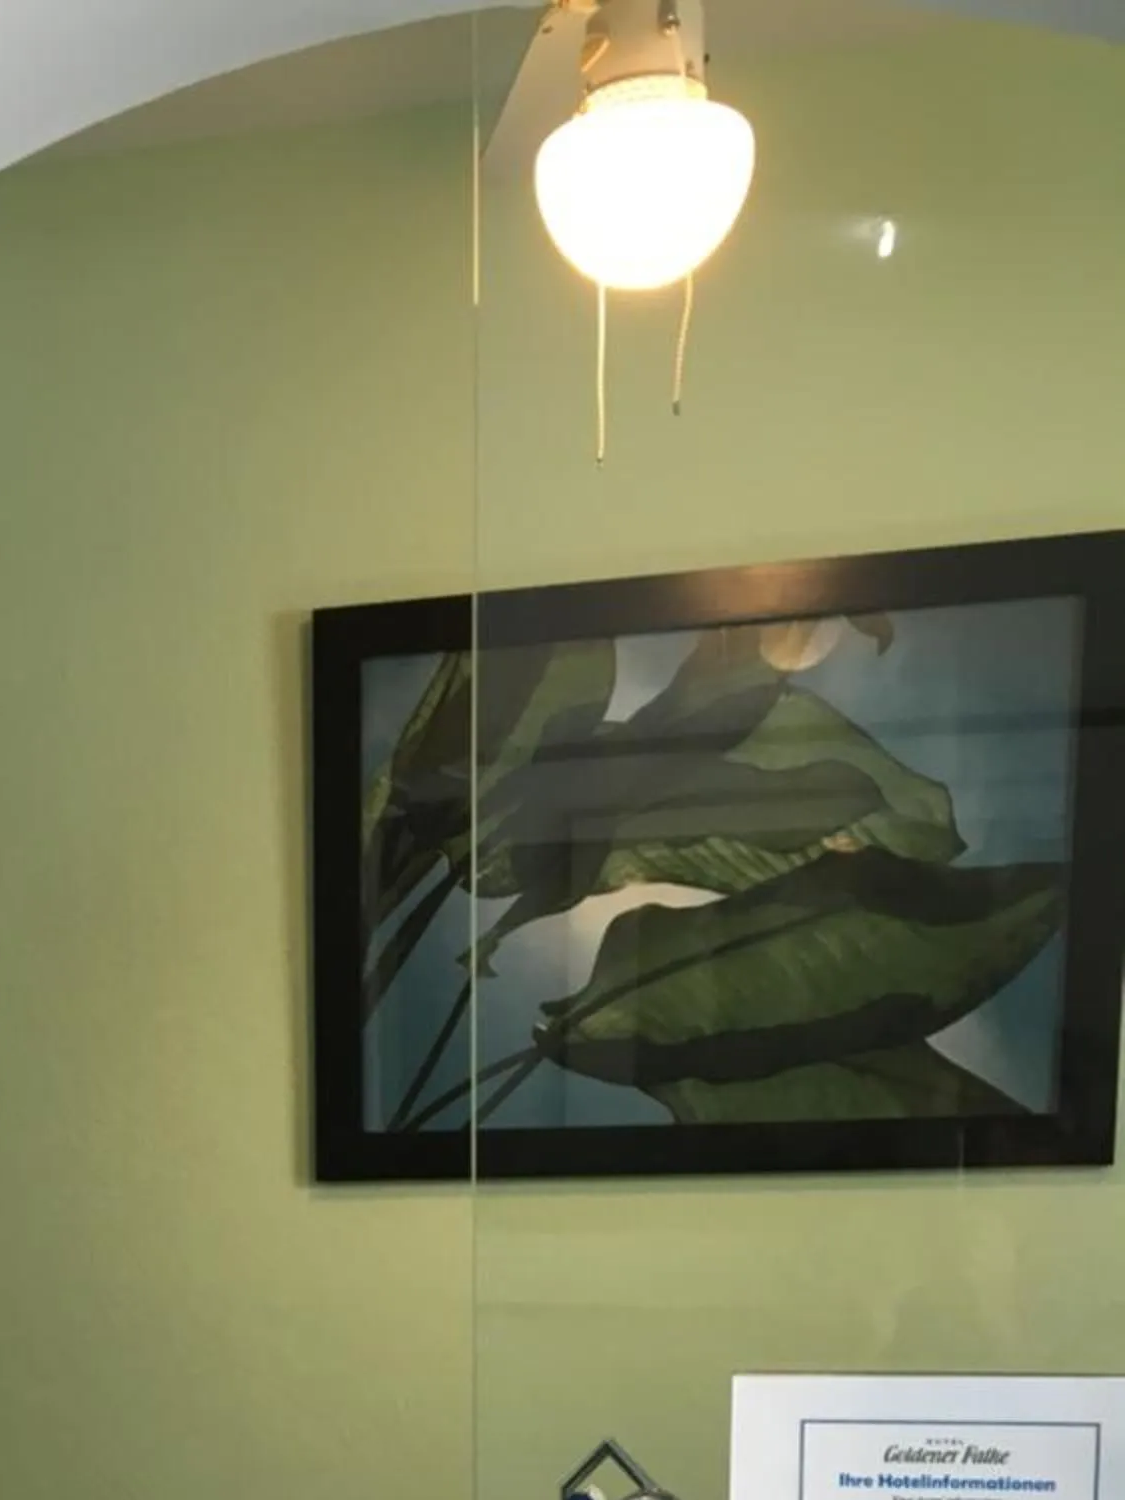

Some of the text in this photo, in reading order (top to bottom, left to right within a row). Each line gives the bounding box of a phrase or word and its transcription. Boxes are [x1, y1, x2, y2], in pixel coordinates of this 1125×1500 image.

[883, 1444, 959, 1464] Goldener
[838, 1472, 1057, 1492] Ihre Hotelinformationen
